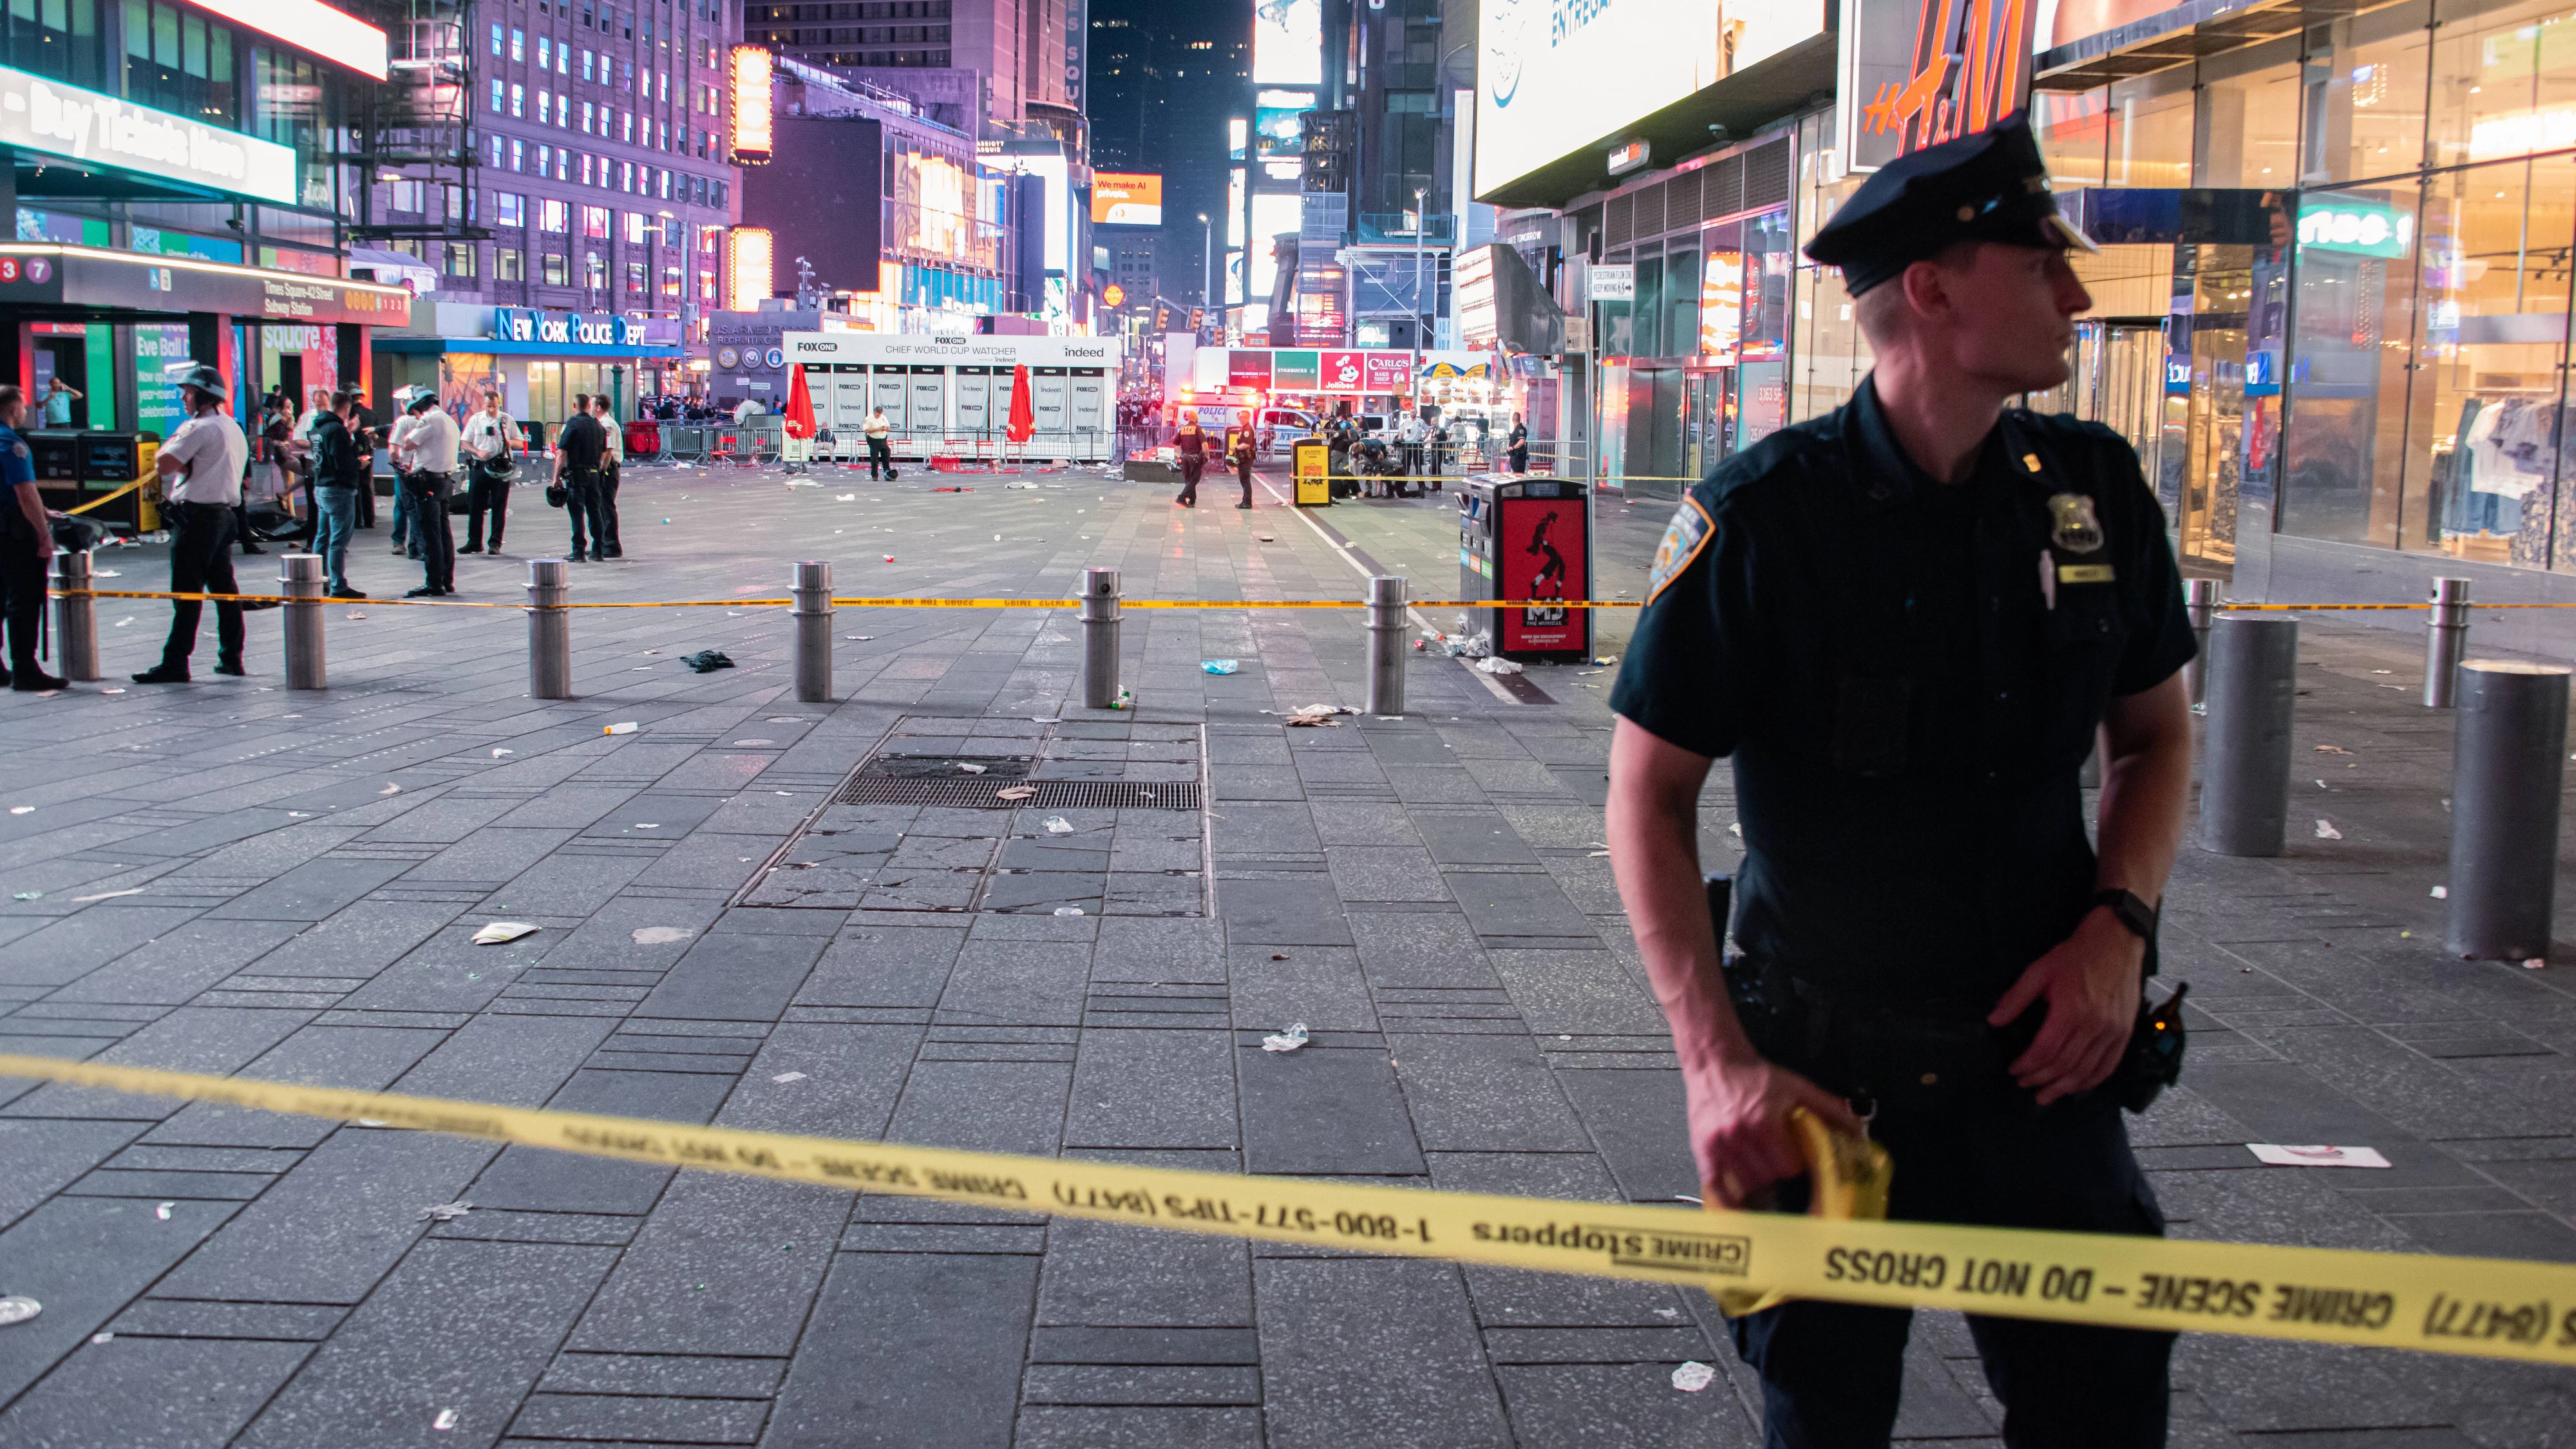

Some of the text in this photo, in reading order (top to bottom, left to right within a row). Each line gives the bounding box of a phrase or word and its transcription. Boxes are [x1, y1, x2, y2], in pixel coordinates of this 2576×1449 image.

[1552, 0, 1611, 48] ENTREGA
[1097, 180, 1112, 189] We
[1113, 181, 1136, 189] make
[3, 262, 45, 278] 3 7
[1594, 270, 1615, 280] PEDESTRIAN
[264, 280, 284, 296] Times
[316, 287, 334, 301] Street
[265, 298, 314, 316] Subway Station
[137, 336, 159, 357] Eve
[159, 335, 182, 357] Ball
[264, 325, 321, 352] square
[798, 343, 837, 351] FOX ONE
[886, 345, 1016, 355] CHIEF WORLD CUP WATCHER
[1064, 346, 1104, 357] indeed
[1198, 407, 1228, 415] POLICE
[1527, 597, 1563, 621] MJ
[1164, 1195, 1435, 1243] 1-800-577-TIPS
[1472, 1221, 1642, 1256] Stoppers
[1651, 1236, 1743, 1263] CRIME
[1824, 1247, 1947, 1289] CROSS
[1955, 1258, 2032, 1297] NOT
[2041, 1265, 2094, 1302] DO
[2136, 1273, 2262, 1318] SCENE
[2268, 1284, 2395, 1329] CRIME
